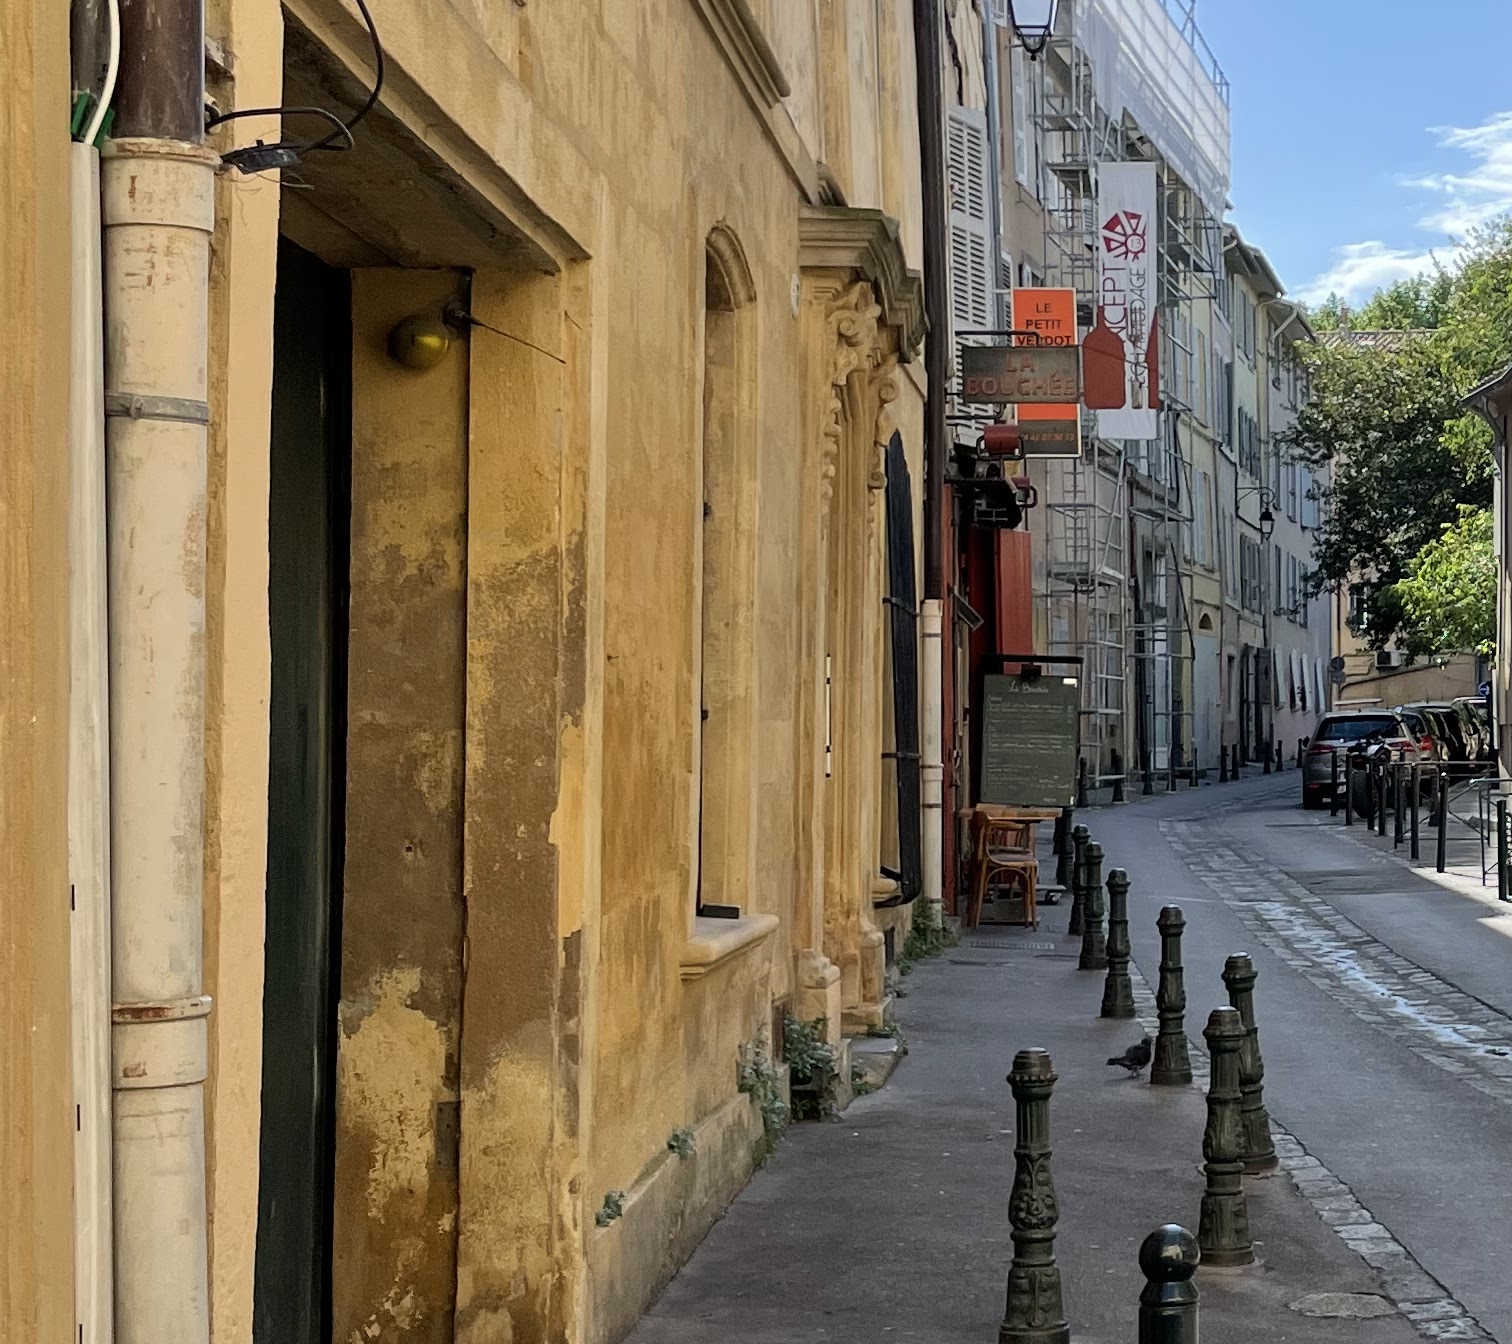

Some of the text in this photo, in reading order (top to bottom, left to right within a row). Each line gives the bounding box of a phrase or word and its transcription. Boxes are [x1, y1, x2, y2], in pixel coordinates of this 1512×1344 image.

[1035, 303, 1052, 314] LE
[1025, 319, 1063, 330] PETIT
[1005, 352, 1036, 373] LA
[966, 373, 1075, 396] BOUCHÉE
